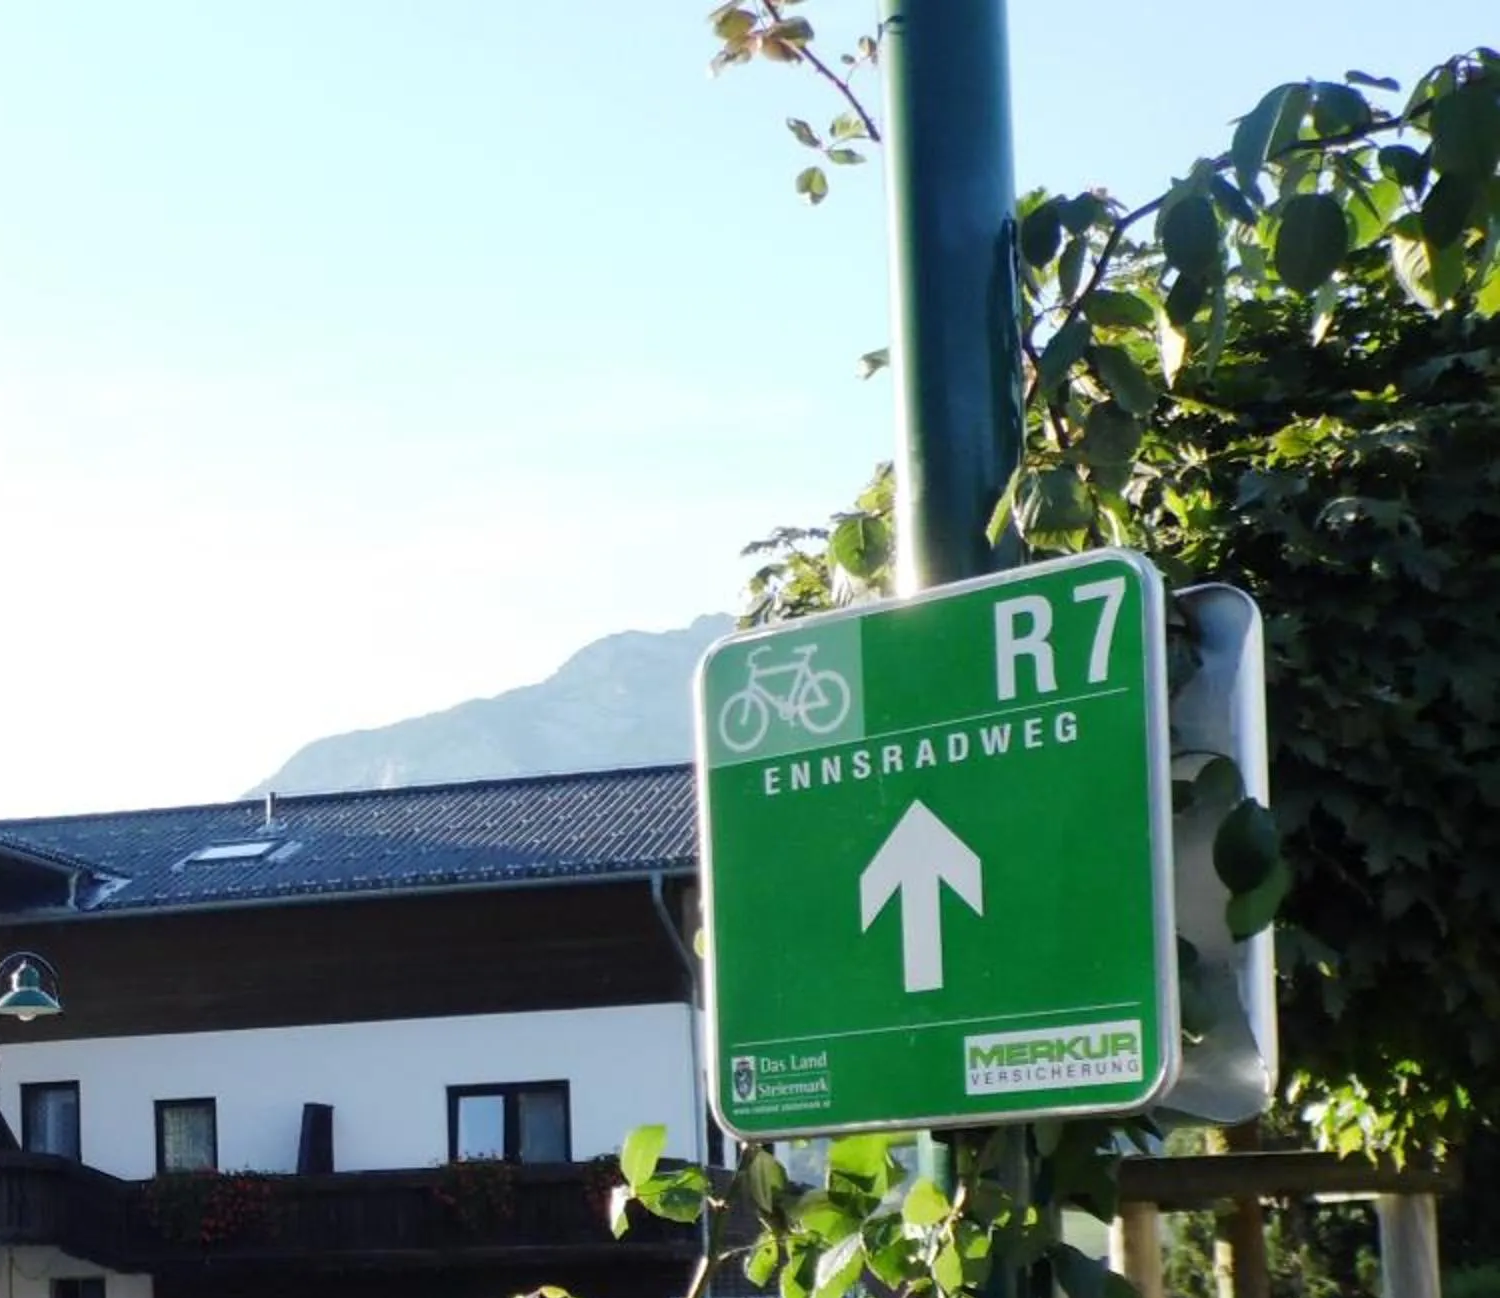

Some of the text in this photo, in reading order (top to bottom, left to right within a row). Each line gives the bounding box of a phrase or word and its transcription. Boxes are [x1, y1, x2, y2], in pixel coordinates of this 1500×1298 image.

[993, 576, 1127, 702] R 7
[764, 711, 1078, 796] ENNSRADWEG
[760, 1050, 827, 1074] Das Land
[969, 1032, 1139, 1069] MERKUR
[971, 1059, 1139, 1086] VERSICHERUNG
